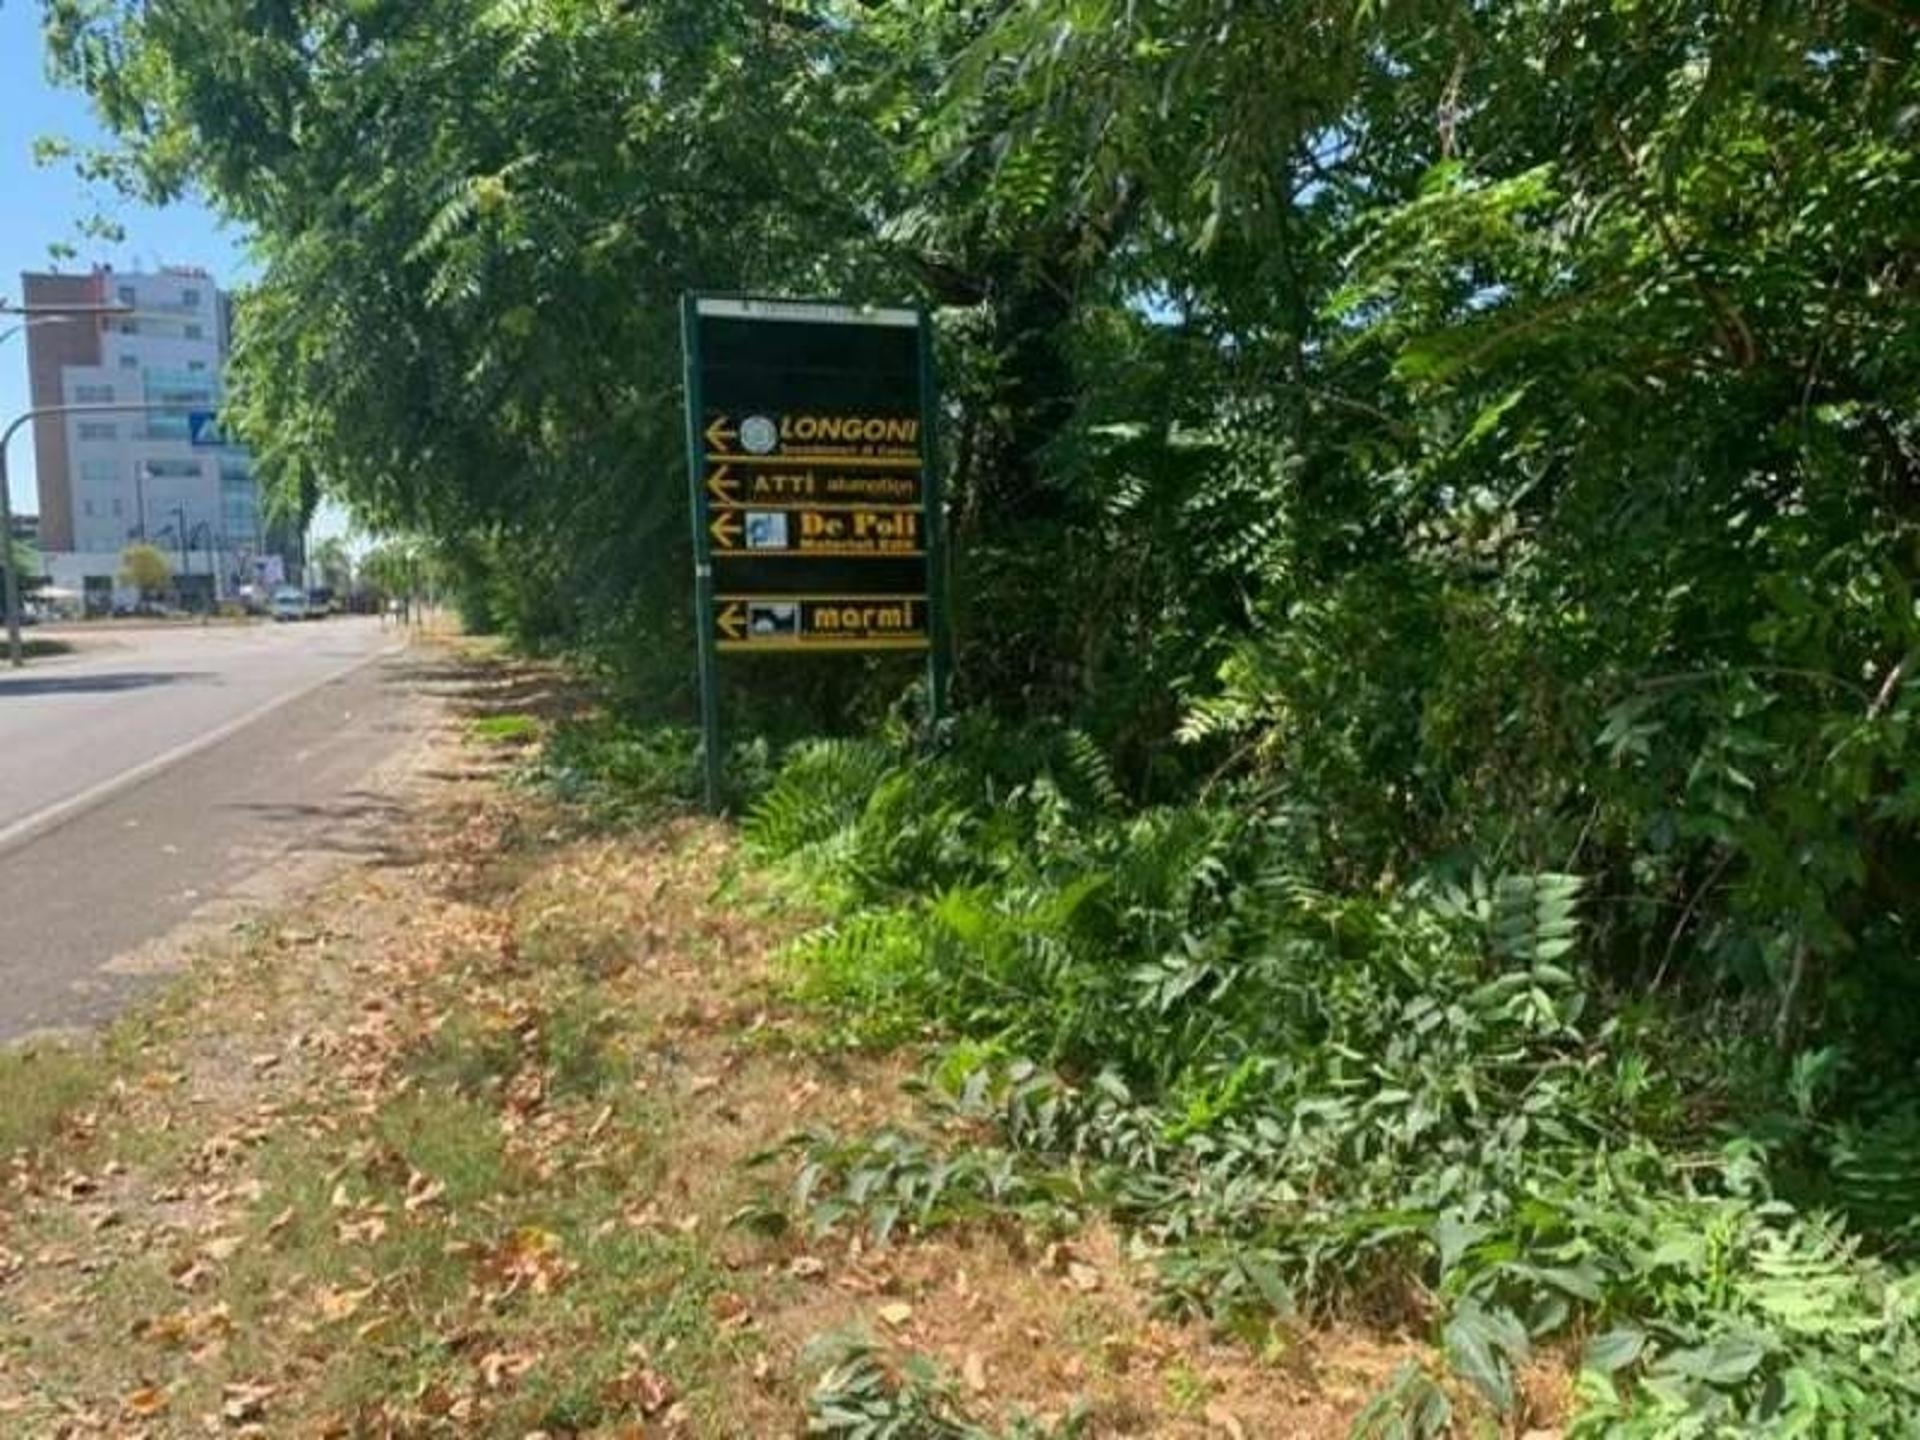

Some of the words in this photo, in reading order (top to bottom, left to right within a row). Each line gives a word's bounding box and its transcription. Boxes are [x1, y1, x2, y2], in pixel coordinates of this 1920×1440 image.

[780, 415, 919, 442] LONGONI
[801, 511, 844, 537] De
[854, 510, 915, 537] Poli
[814, 600, 912, 628] marmi
